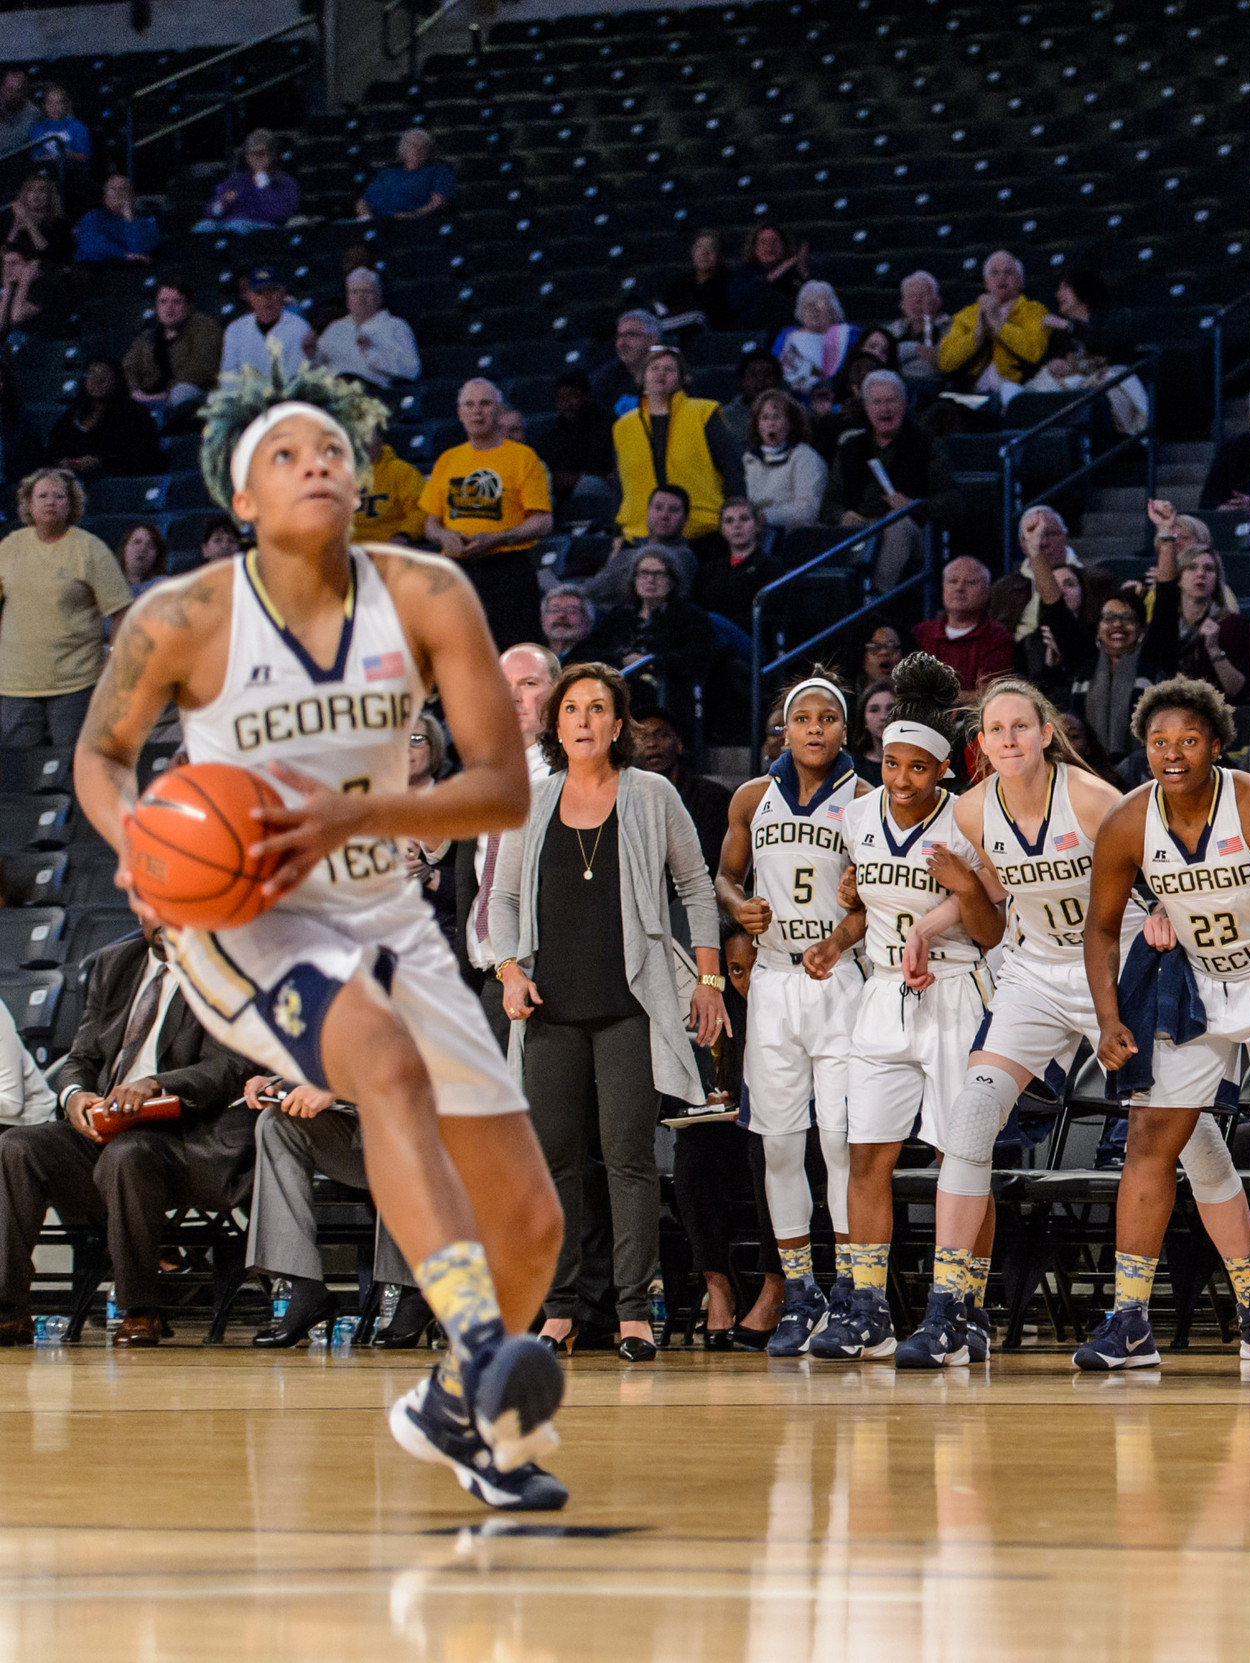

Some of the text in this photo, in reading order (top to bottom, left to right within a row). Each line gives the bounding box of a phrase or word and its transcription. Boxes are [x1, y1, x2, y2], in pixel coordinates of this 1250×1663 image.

[793, 866, 815, 906] 5
[778, 919, 834, 941] TECH
[1044, 898, 1084, 929] 10
[1189, 912, 1240, 949] 23
